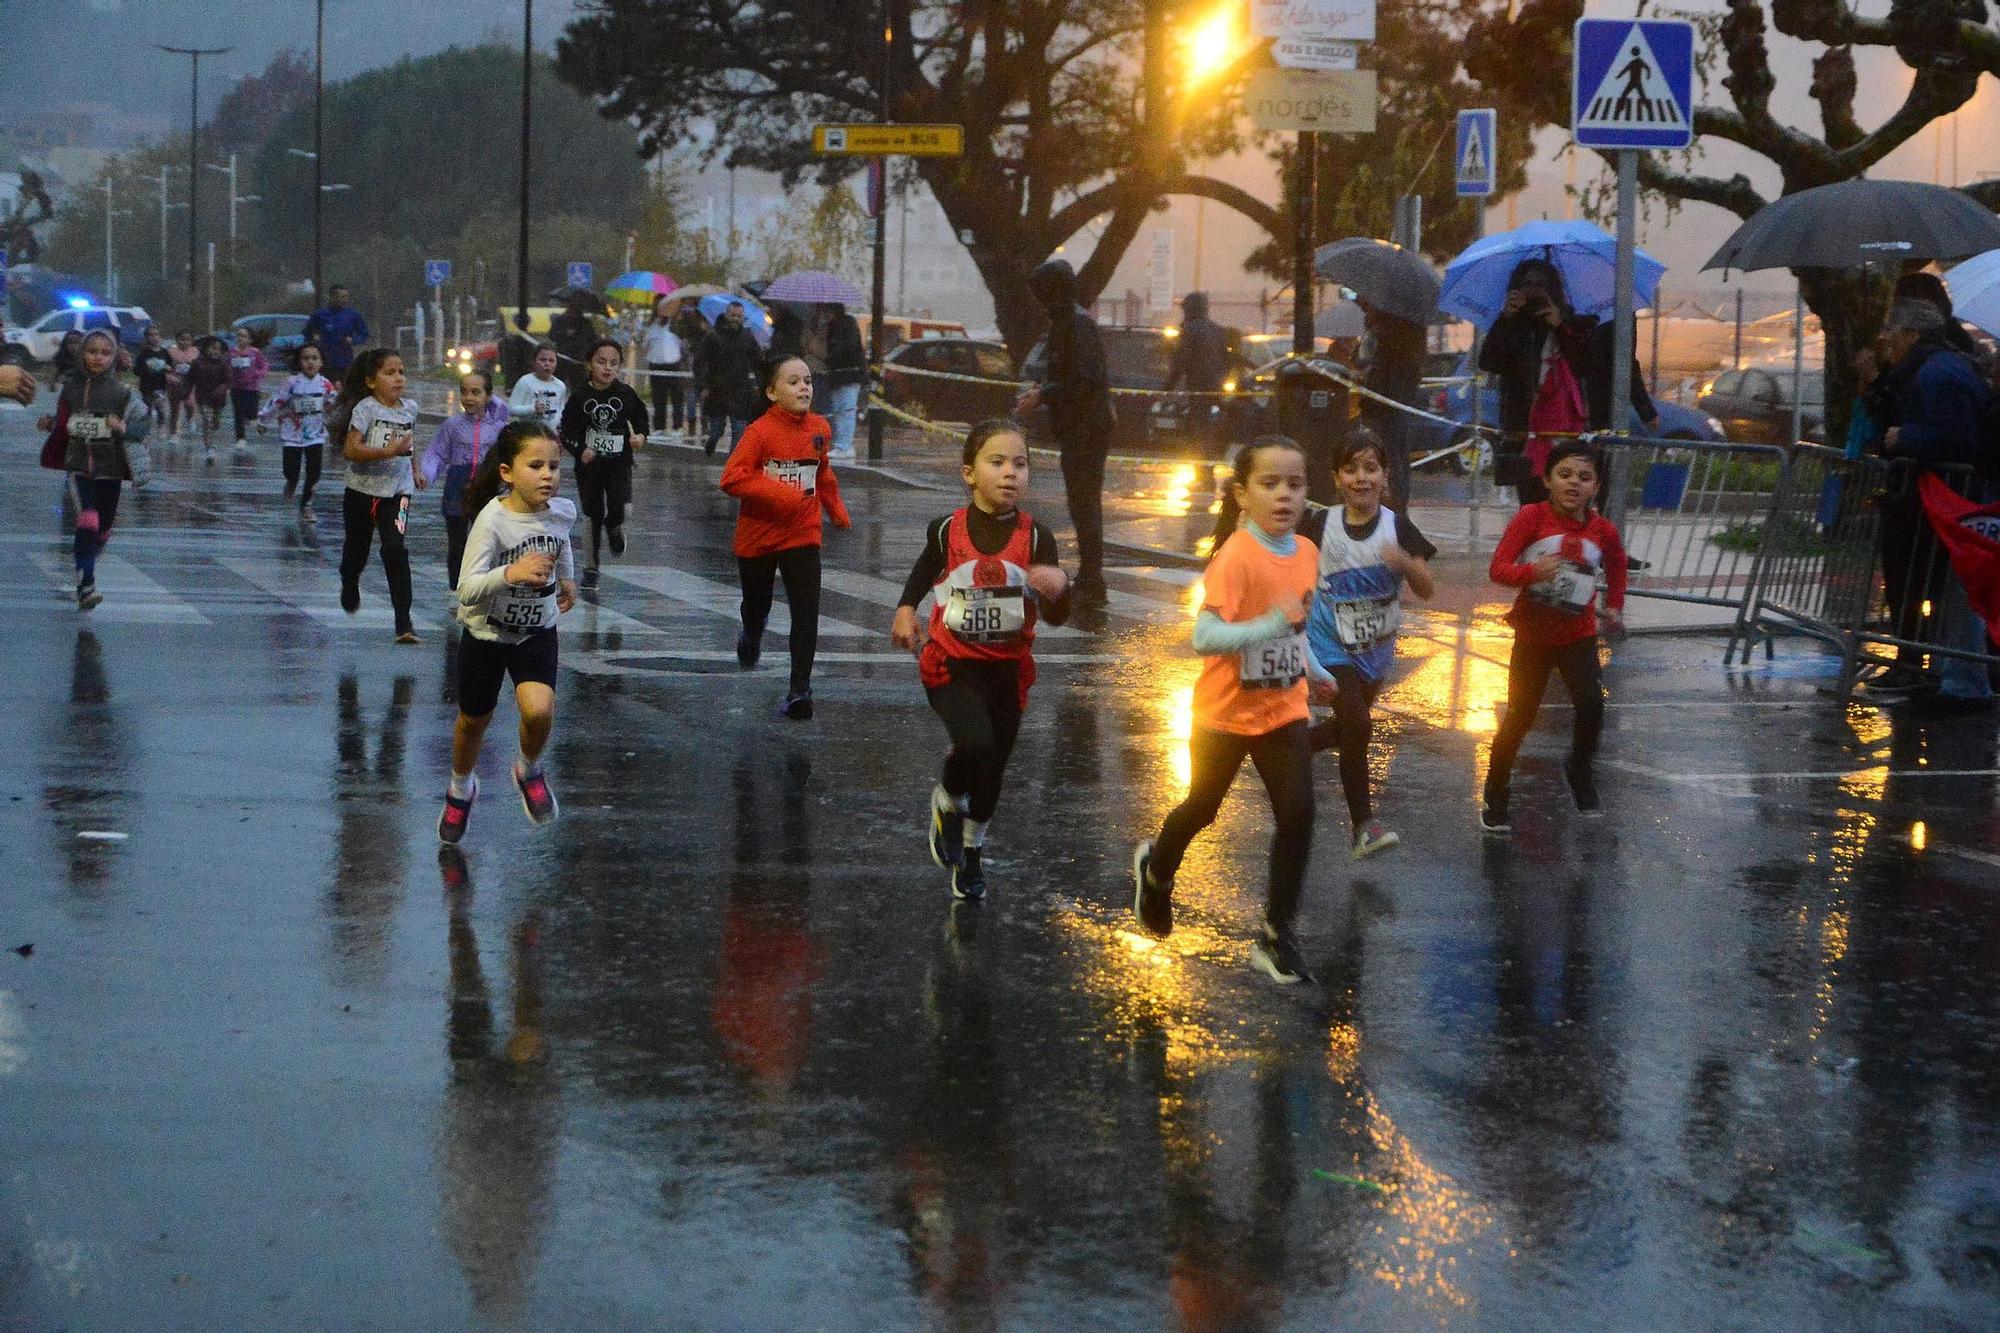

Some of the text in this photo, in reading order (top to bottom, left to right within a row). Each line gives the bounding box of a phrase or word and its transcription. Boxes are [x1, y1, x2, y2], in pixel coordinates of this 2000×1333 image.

[593, 438, 615, 452] 543
[503, 604, 543, 626] 535
[961, 606, 1001, 632] 568
